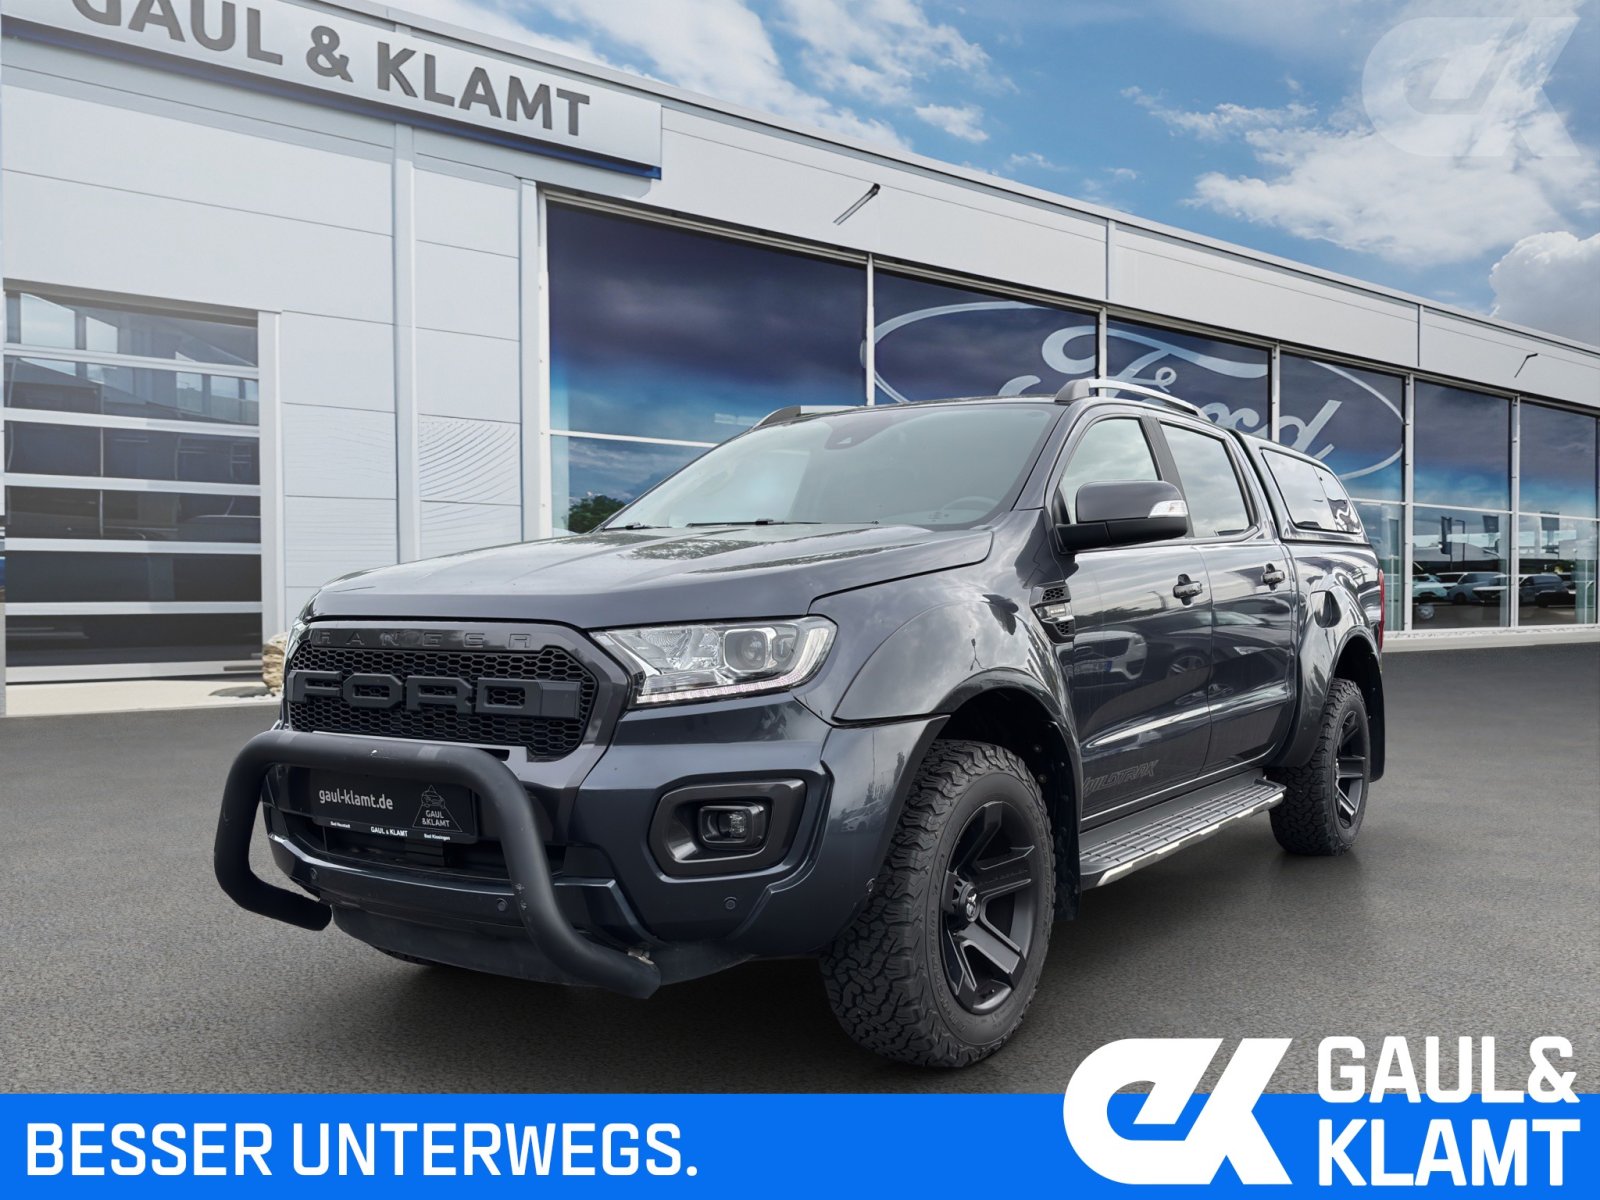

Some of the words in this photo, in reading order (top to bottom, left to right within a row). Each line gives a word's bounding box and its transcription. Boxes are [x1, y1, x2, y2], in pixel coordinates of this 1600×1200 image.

[306, 26, 353, 83] &
[377, 42, 590, 137] KLAMT
[288, 670, 543, 718] FORD
[319, 788, 394, 810] gaul-klamt.de
[425, 810, 444, 818] GAUL
[371, 826, 384, 834] GAUL
[390, 829, 408, 837] KLAMT
